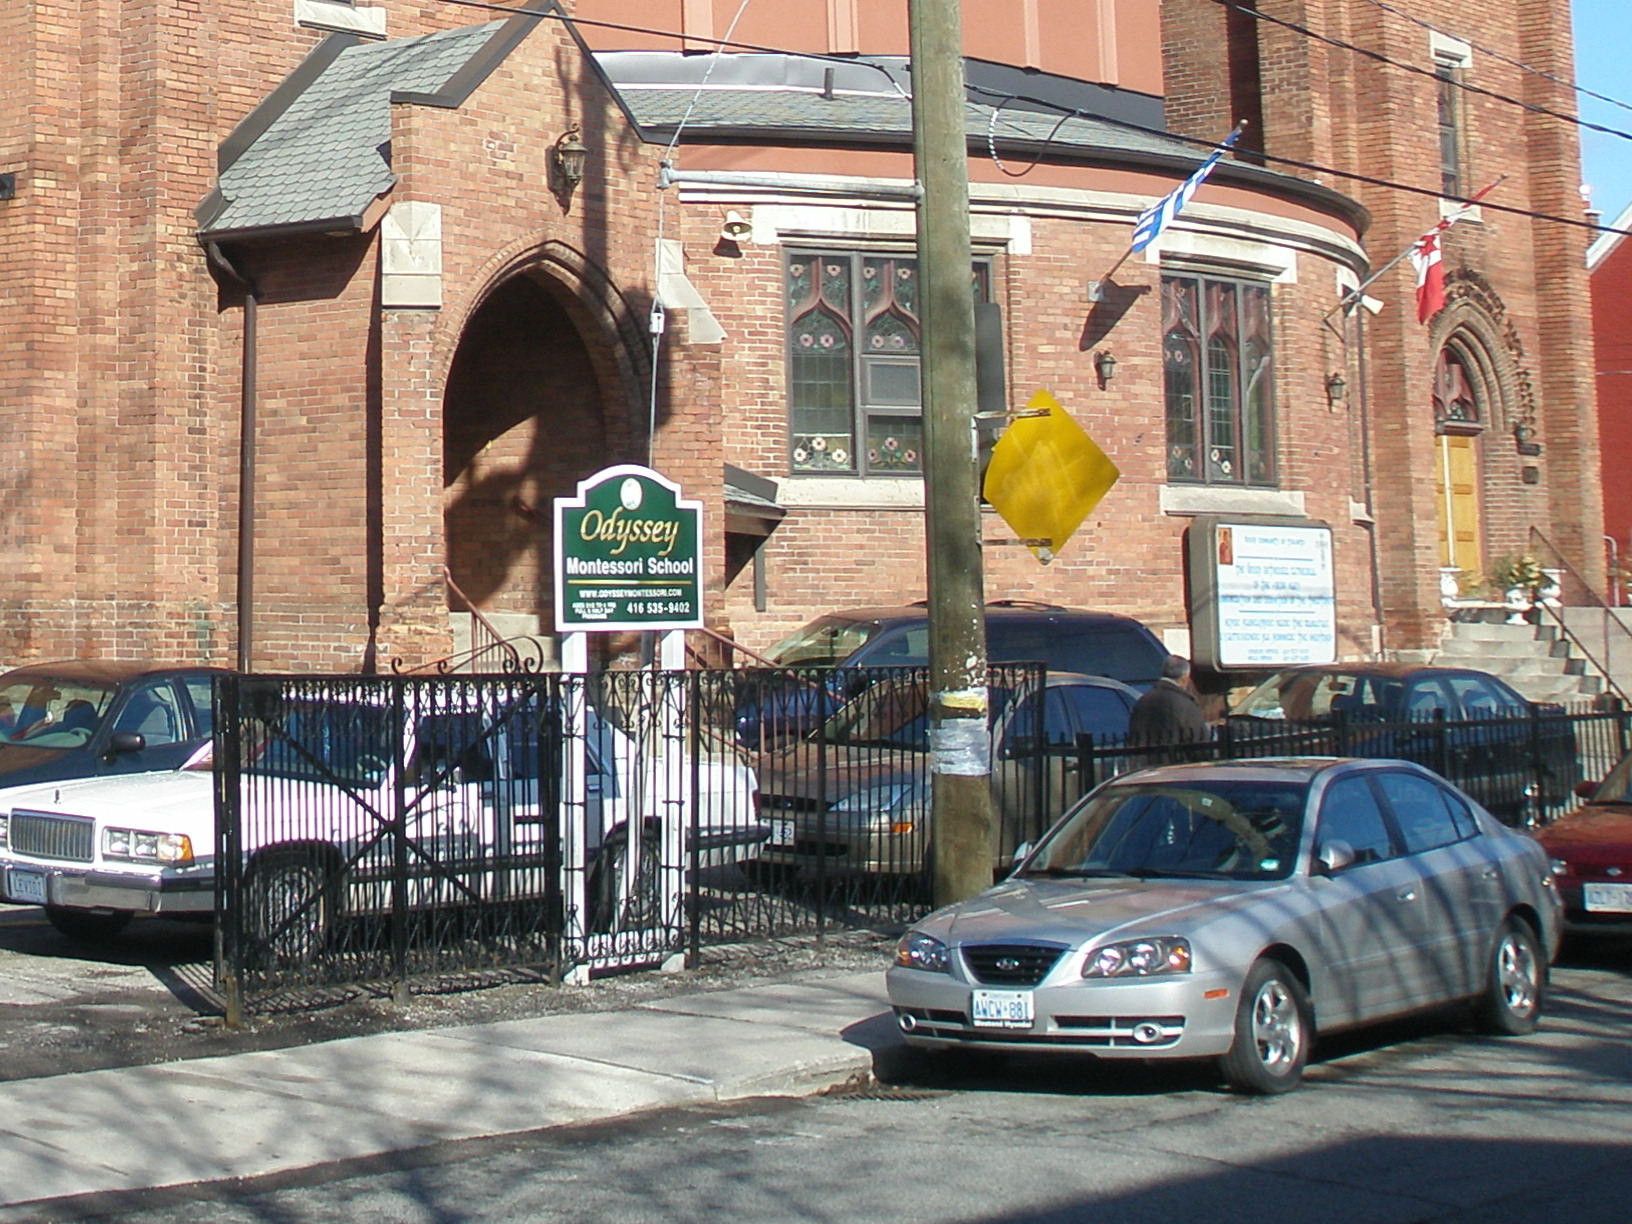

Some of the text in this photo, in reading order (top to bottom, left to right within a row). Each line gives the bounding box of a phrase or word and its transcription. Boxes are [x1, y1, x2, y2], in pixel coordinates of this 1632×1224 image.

[580, 506, 679, 556] Odyssey
[566, 557, 694, 575] Montessori School
[626, 602, 645, 614] 416
[646, 602, 690, 614] 535-9402
